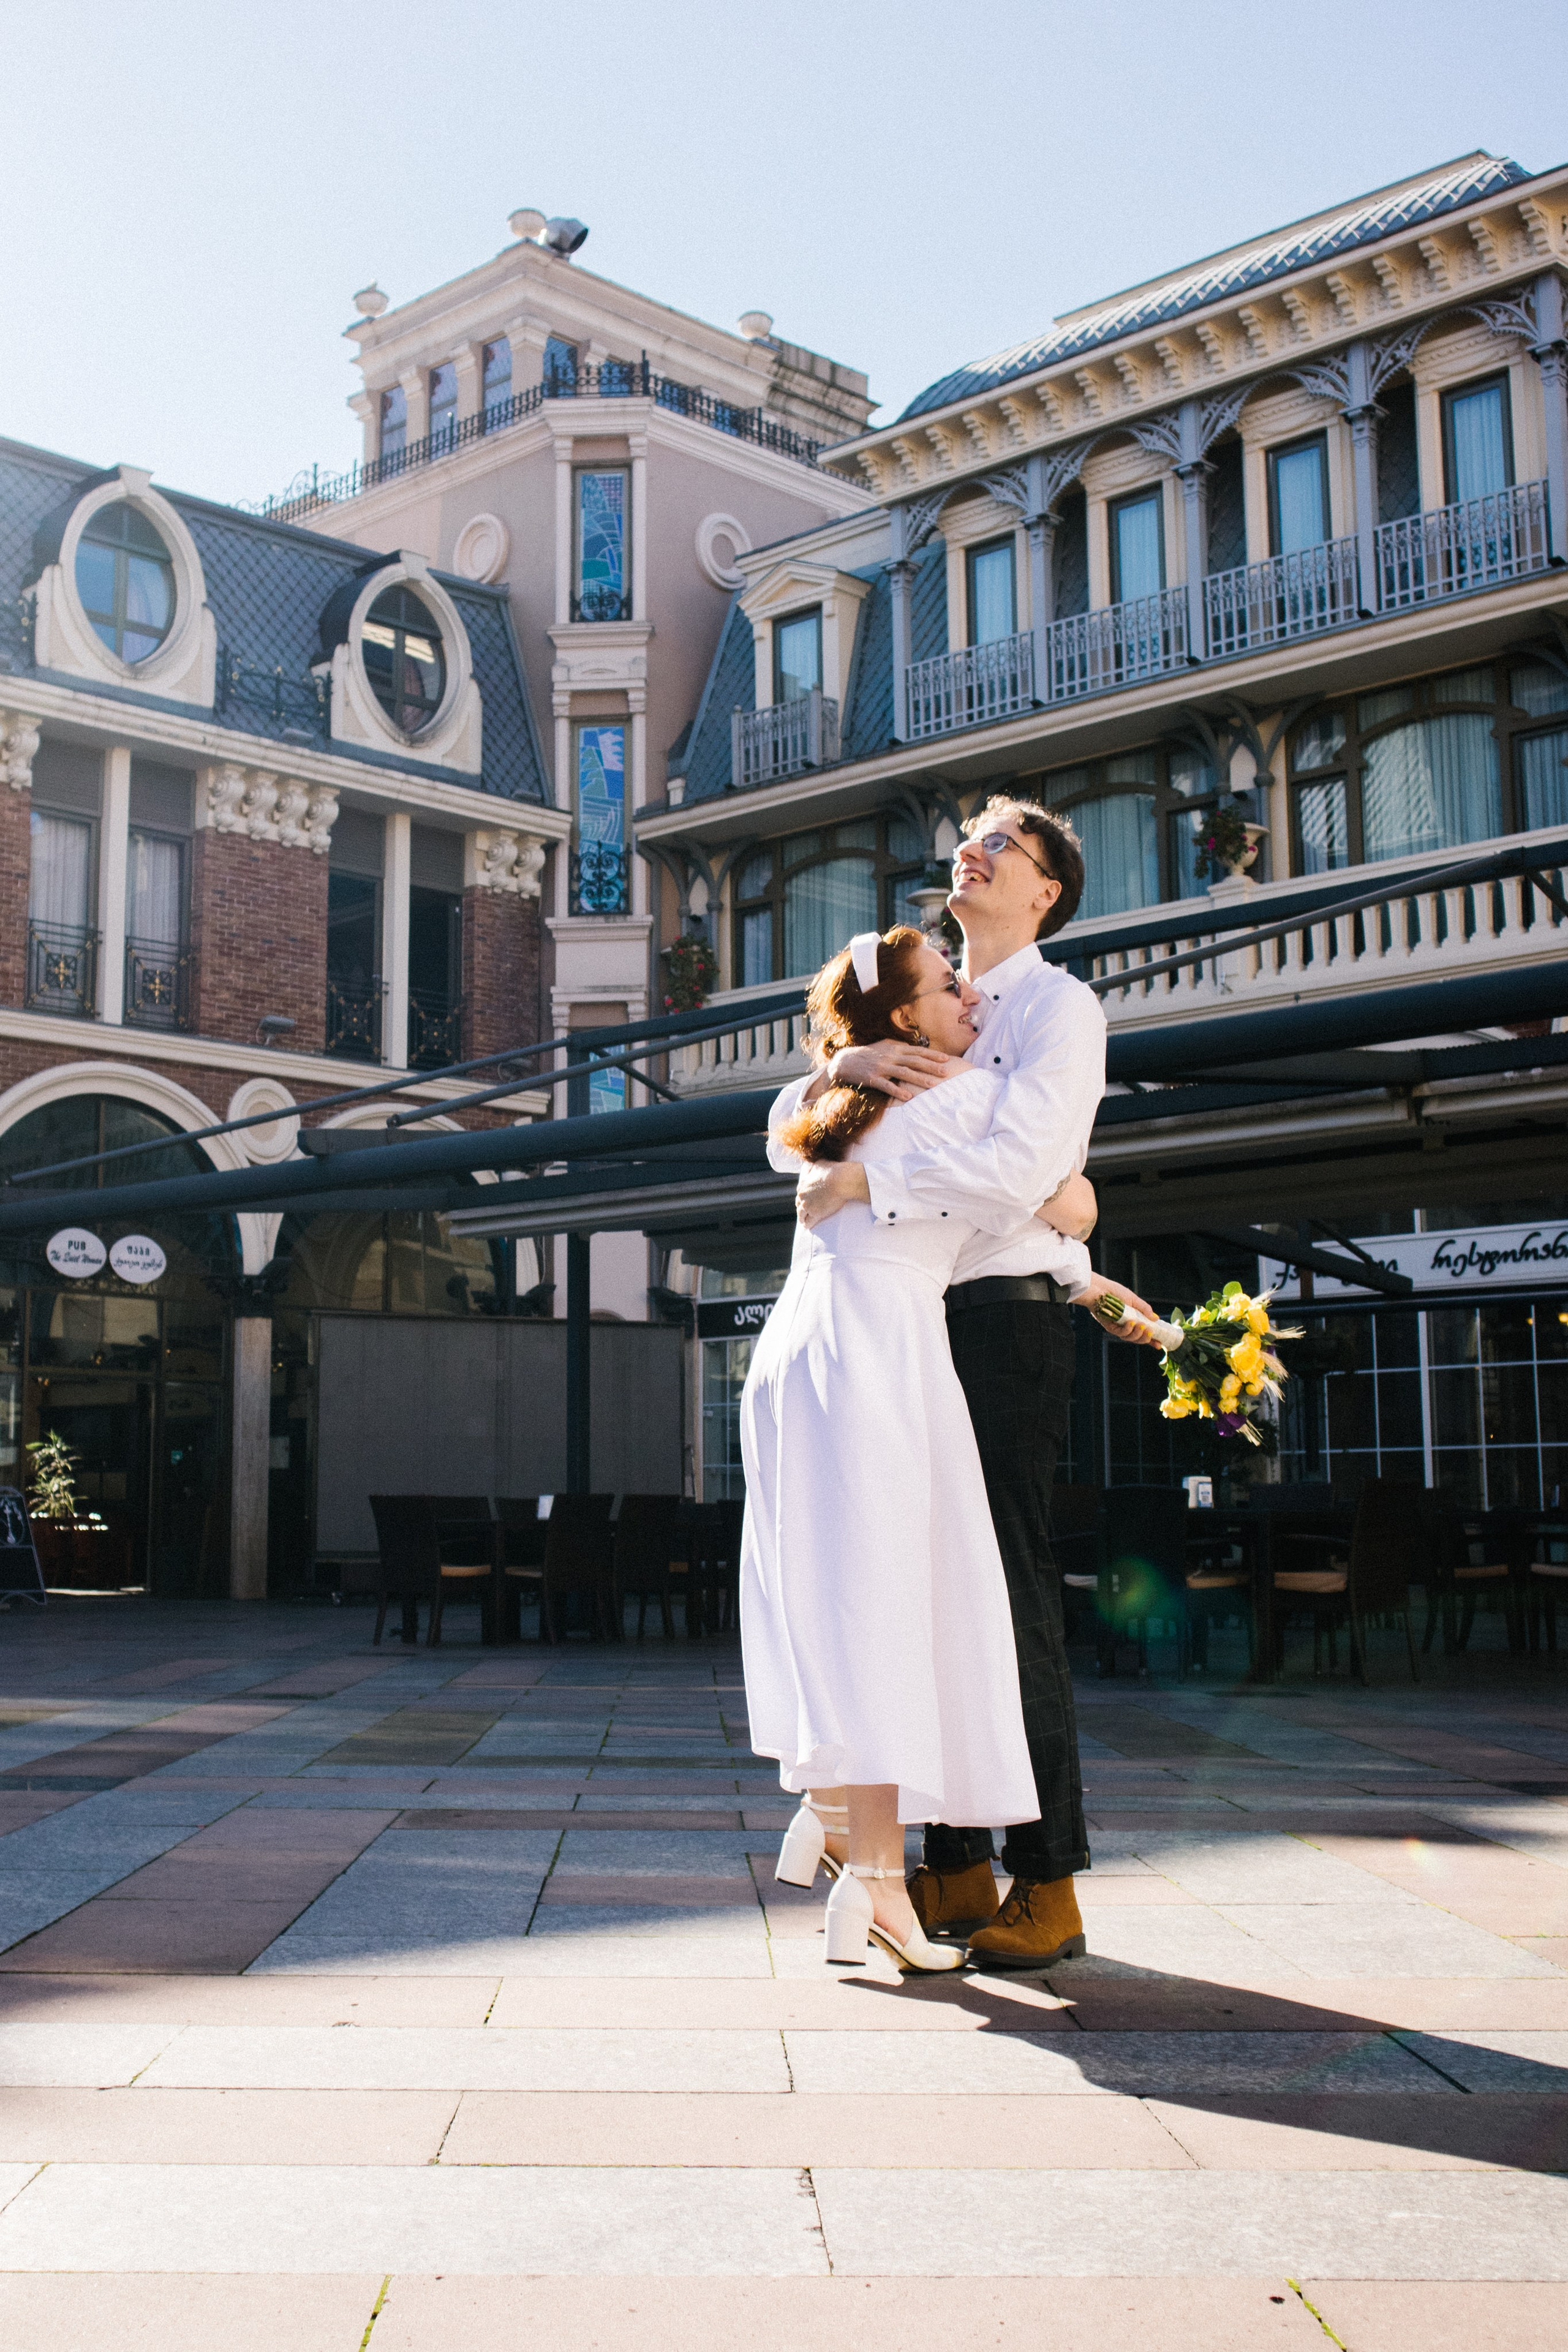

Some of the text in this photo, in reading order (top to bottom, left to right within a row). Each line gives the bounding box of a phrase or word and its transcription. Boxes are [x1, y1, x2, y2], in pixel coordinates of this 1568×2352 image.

[68, 1240, 86, 1251] PUB
[50, 1250, 61, 1261] The
[1431, 1231, 1568, 1277] რესტორან
